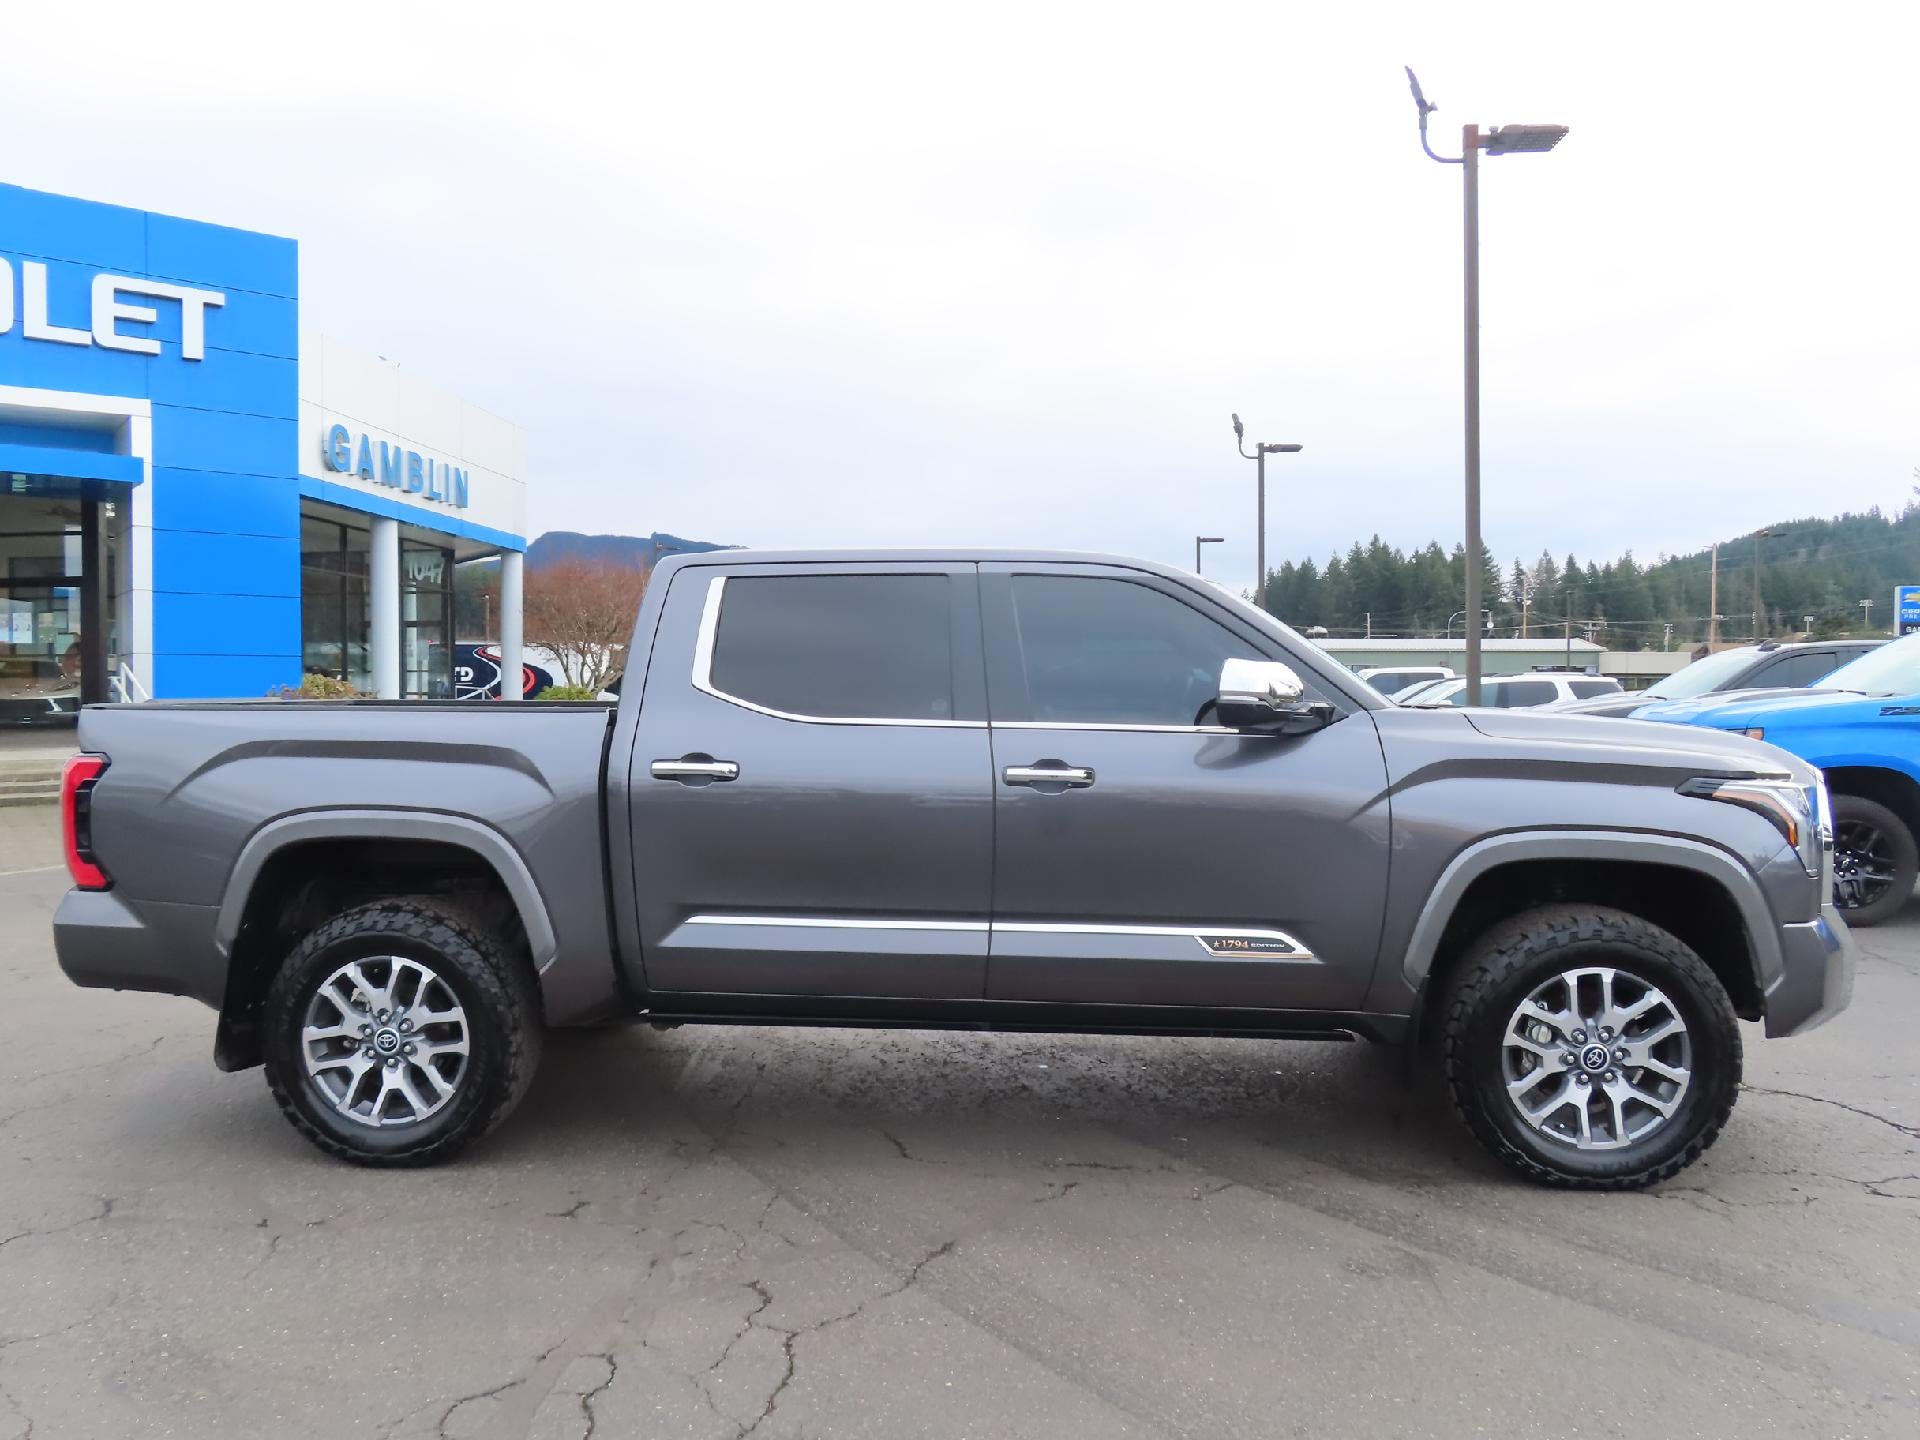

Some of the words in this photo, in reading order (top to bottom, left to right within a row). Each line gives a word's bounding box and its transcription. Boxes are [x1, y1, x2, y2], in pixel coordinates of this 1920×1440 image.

[0, 256, 225, 361] LET
[324, 423, 468, 508] GAMBLIN
[1221, 939, 1249, 949] 1794
